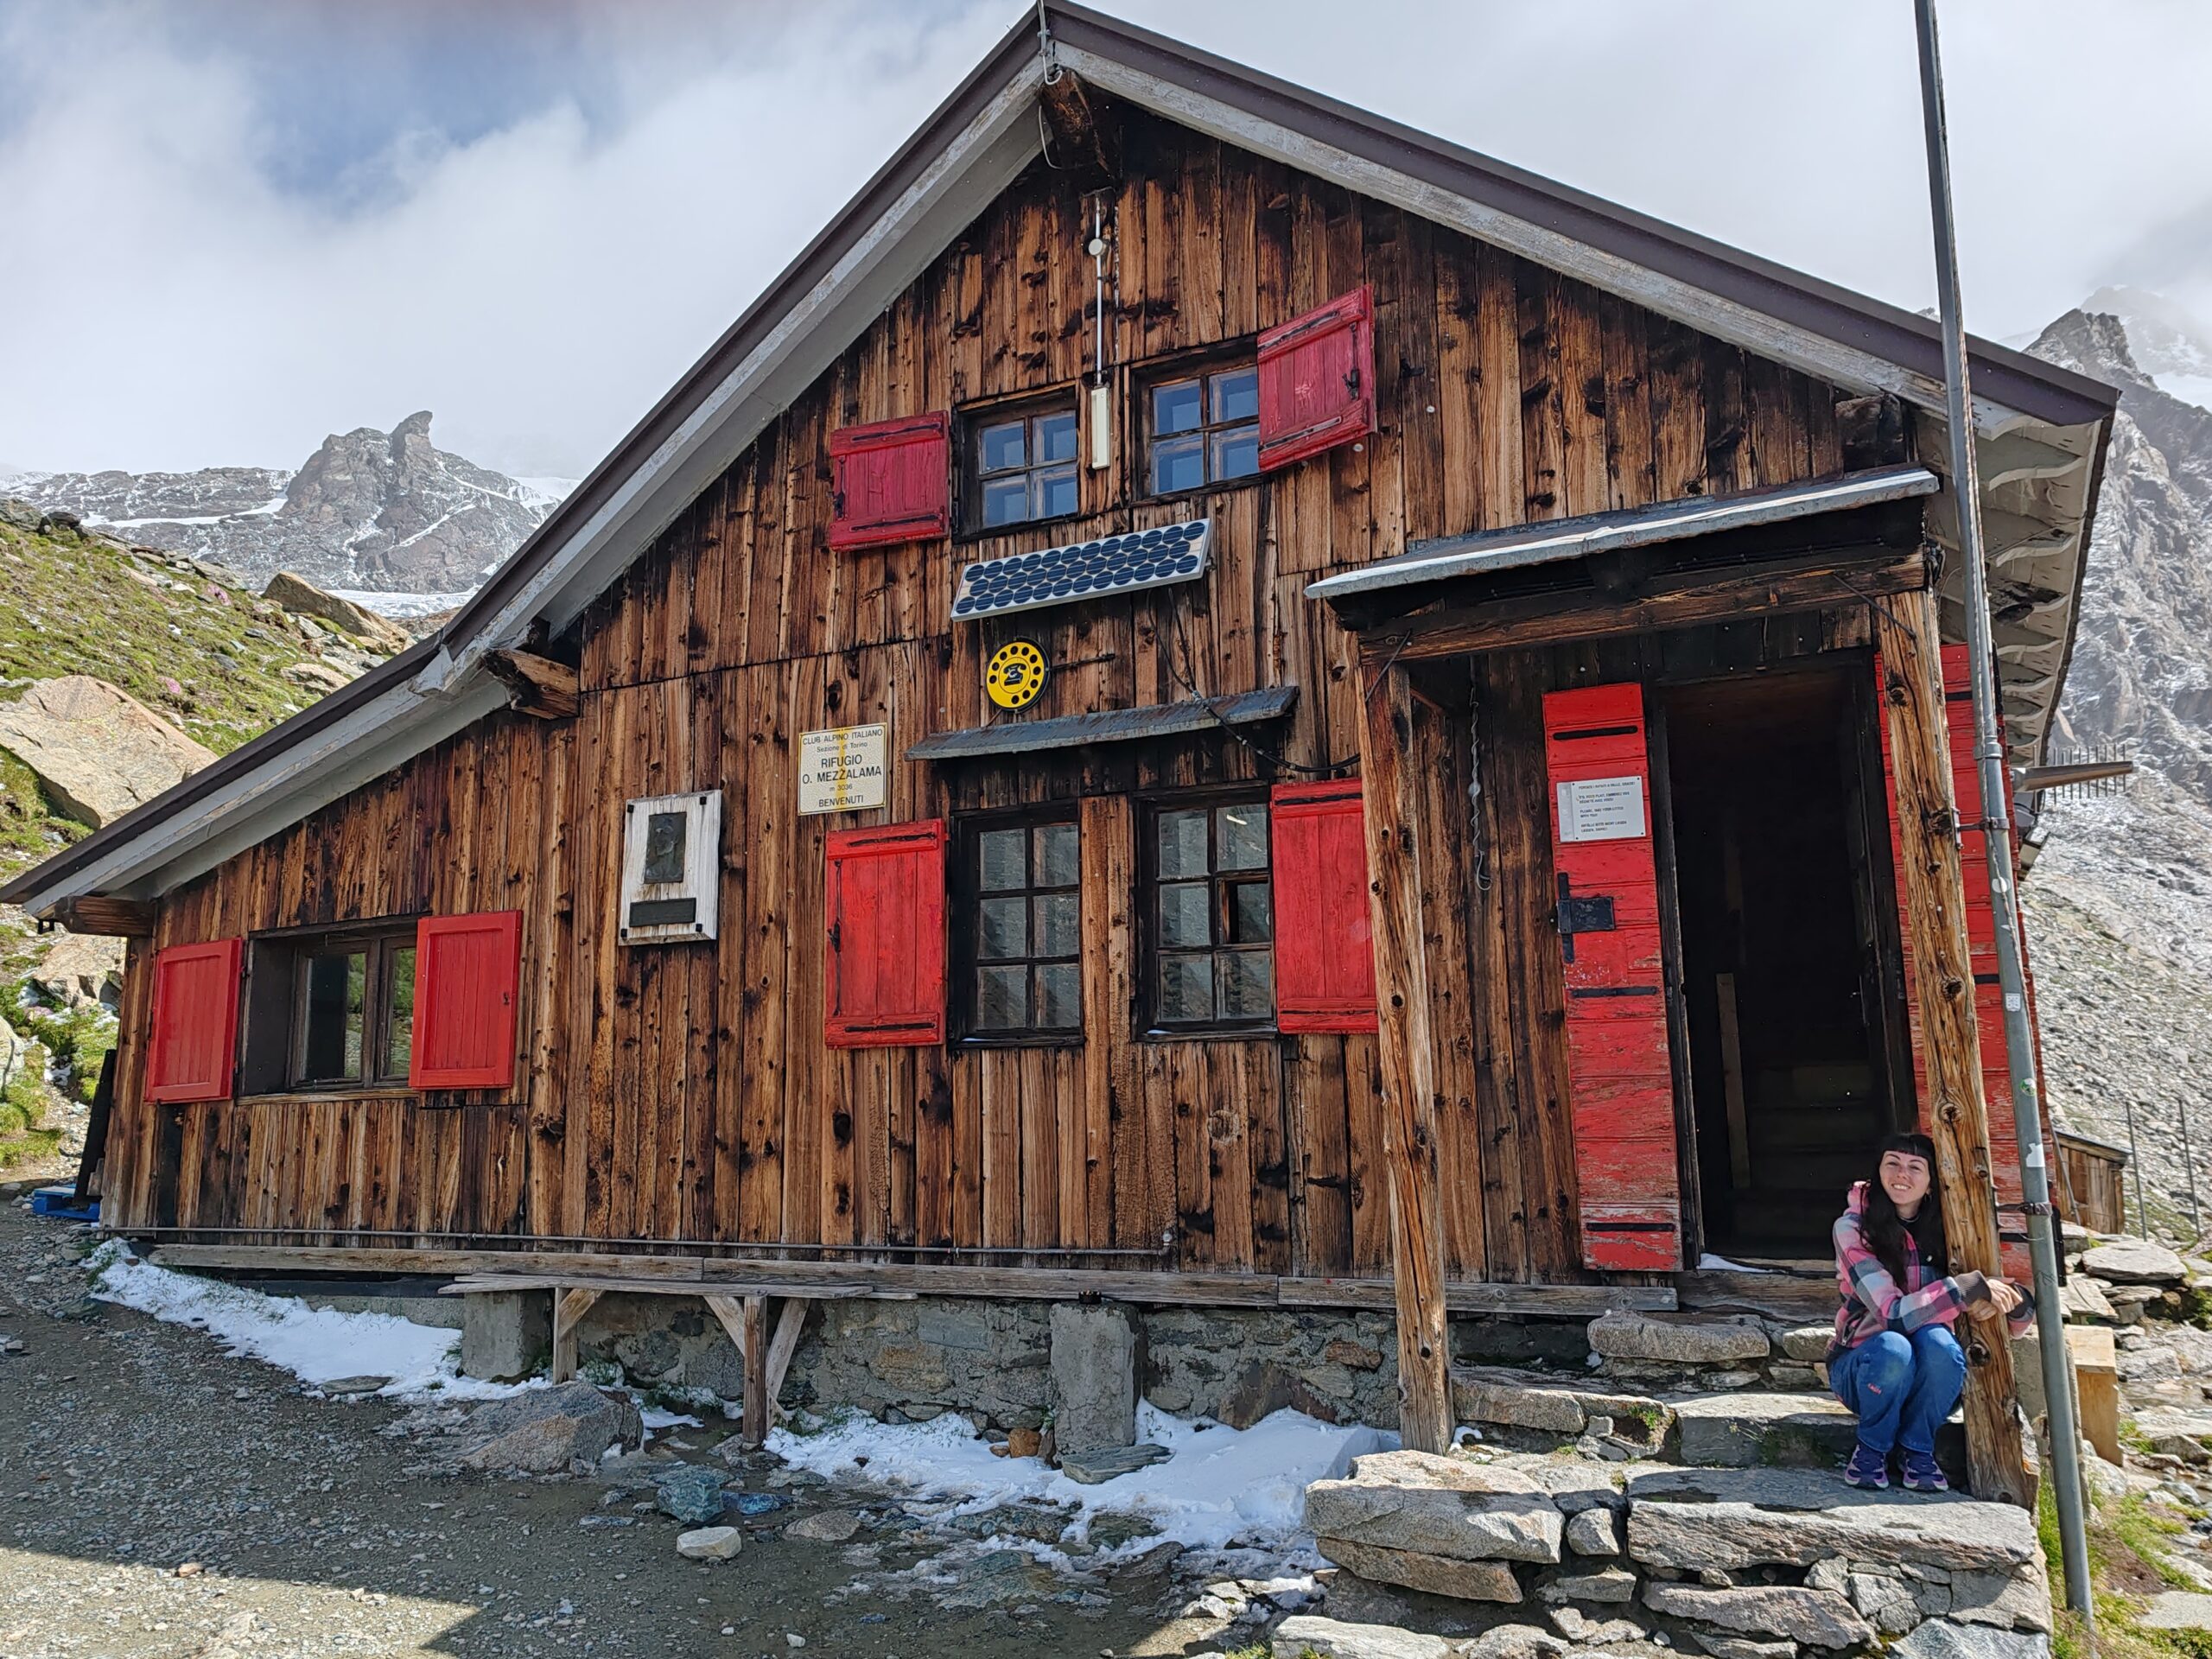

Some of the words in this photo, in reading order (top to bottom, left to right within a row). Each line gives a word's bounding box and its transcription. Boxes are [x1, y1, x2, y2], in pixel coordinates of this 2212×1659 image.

[803, 736, 820, 745] CLUB
[823, 734, 849, 742] ALPINO
[852, 728, 882, 739] ITALIANO
[821, 753, 862, 768] RIFUGIO
[802, 774, 812, 784] O.
[817, 766, 882, 783] MEZZALAMA
[818, 795, 864, 807] BENVENUTI
